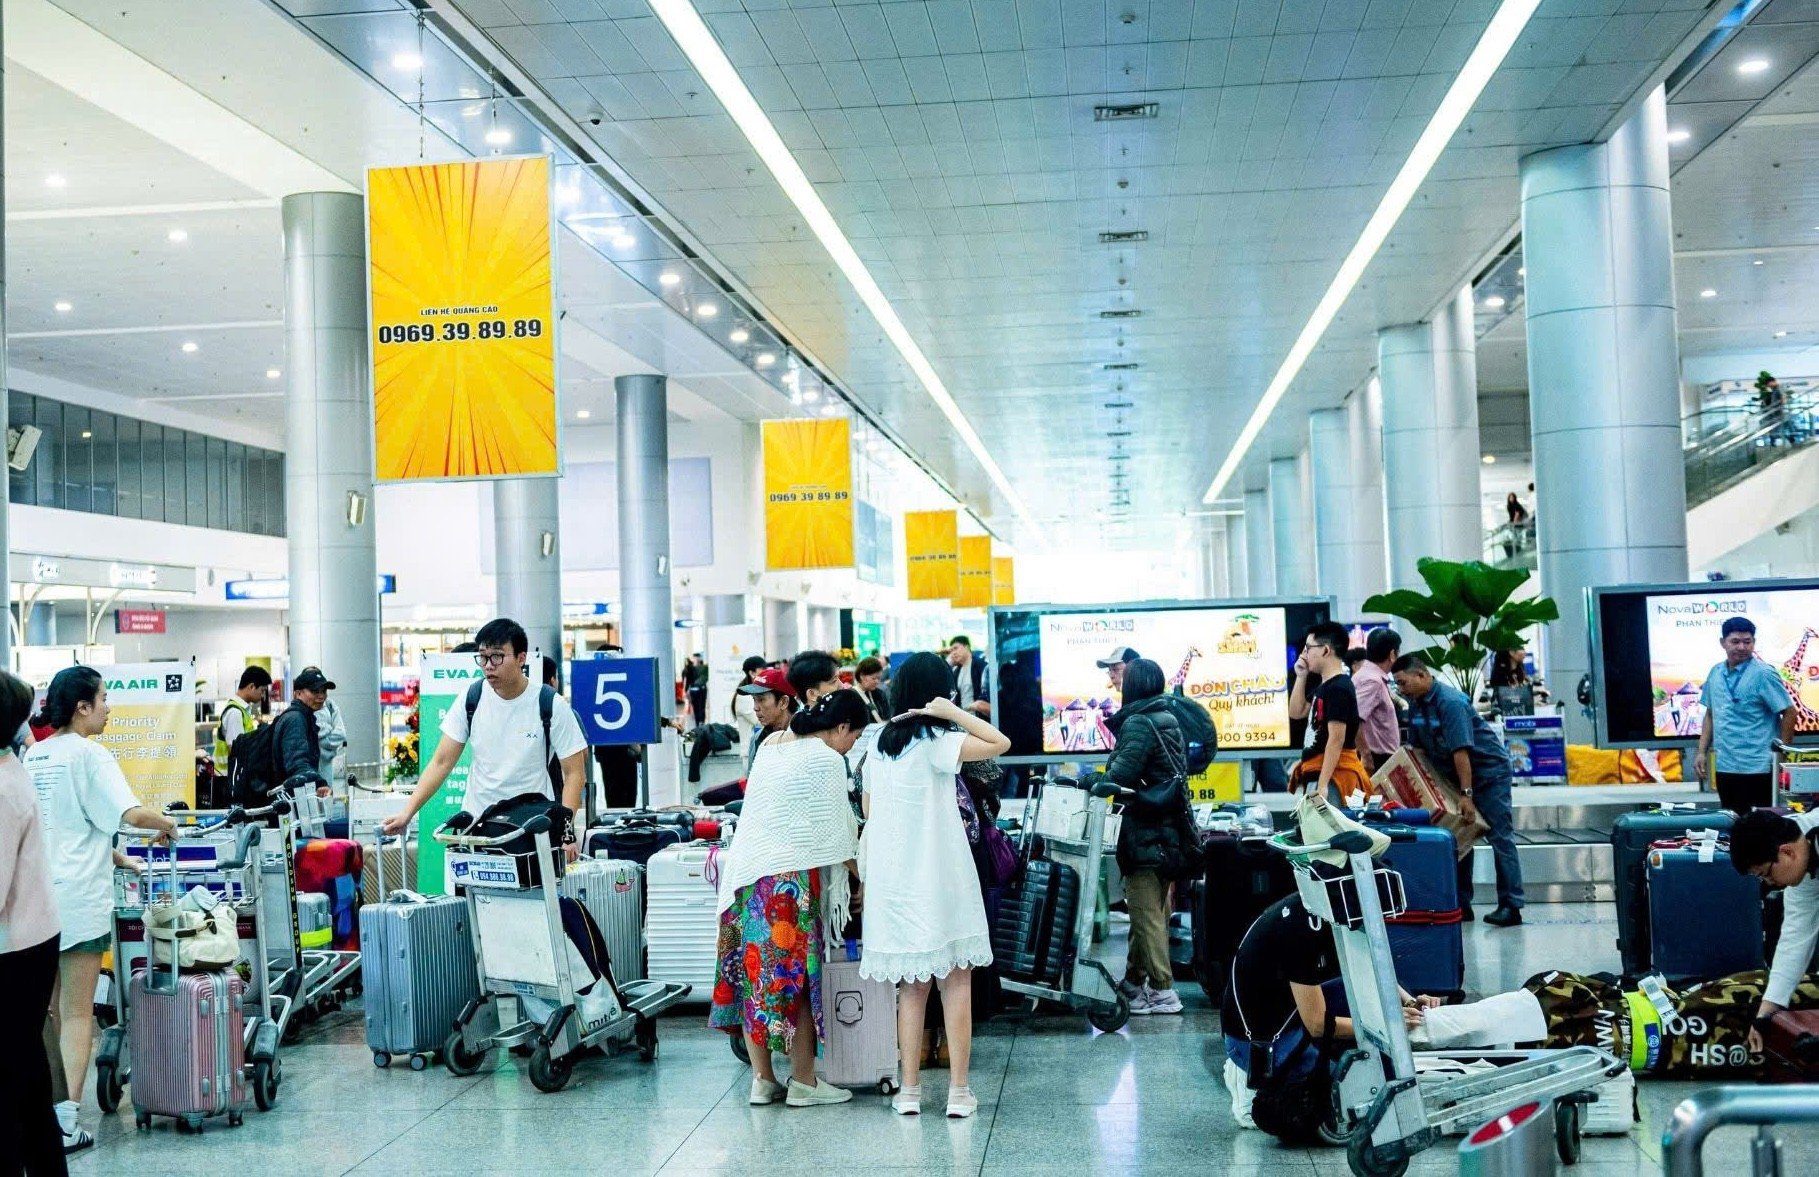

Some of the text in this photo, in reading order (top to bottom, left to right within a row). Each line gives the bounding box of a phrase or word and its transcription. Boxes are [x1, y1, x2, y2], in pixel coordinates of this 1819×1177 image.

[378, 318, 542, 344] 0969.39.89.89
[433, 669, 469, 679] EVA
[104, 679, 158, 690] VA AIR
[593, 672, 631, 730] 5
[112, 716, 160, 729] Priority
[146, 731, 176, 740] Claim
[1245, 731, 1276, 741] 9394
